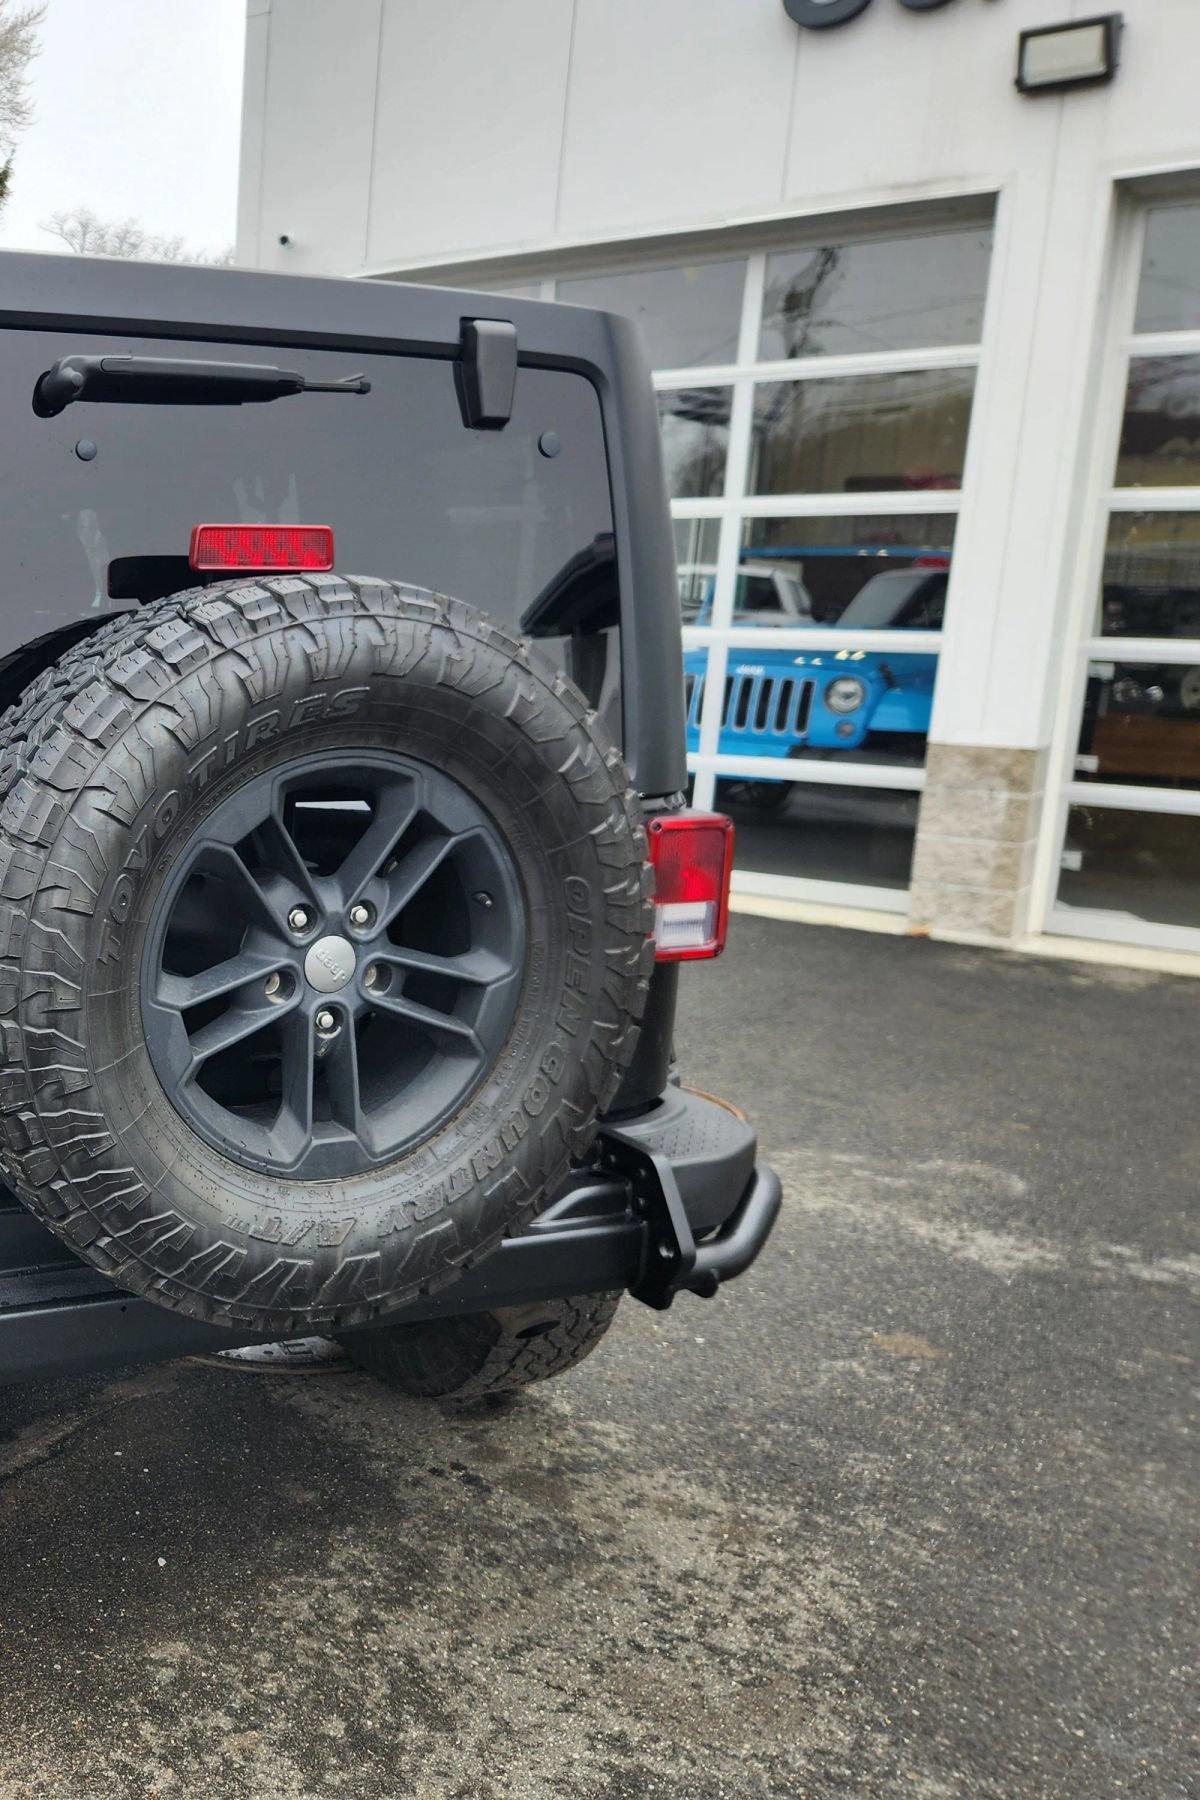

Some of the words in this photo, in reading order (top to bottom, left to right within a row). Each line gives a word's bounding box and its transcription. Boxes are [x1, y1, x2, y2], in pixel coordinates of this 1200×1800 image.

[97, 789, 183, 965] TOYO
[187, 686, 371, 790] TIRES
[315, 948, 348, 983] Jeep
[555, 875, 595, 1039] OPEN
[376, 1042, 568, 1238] COUNTRY
